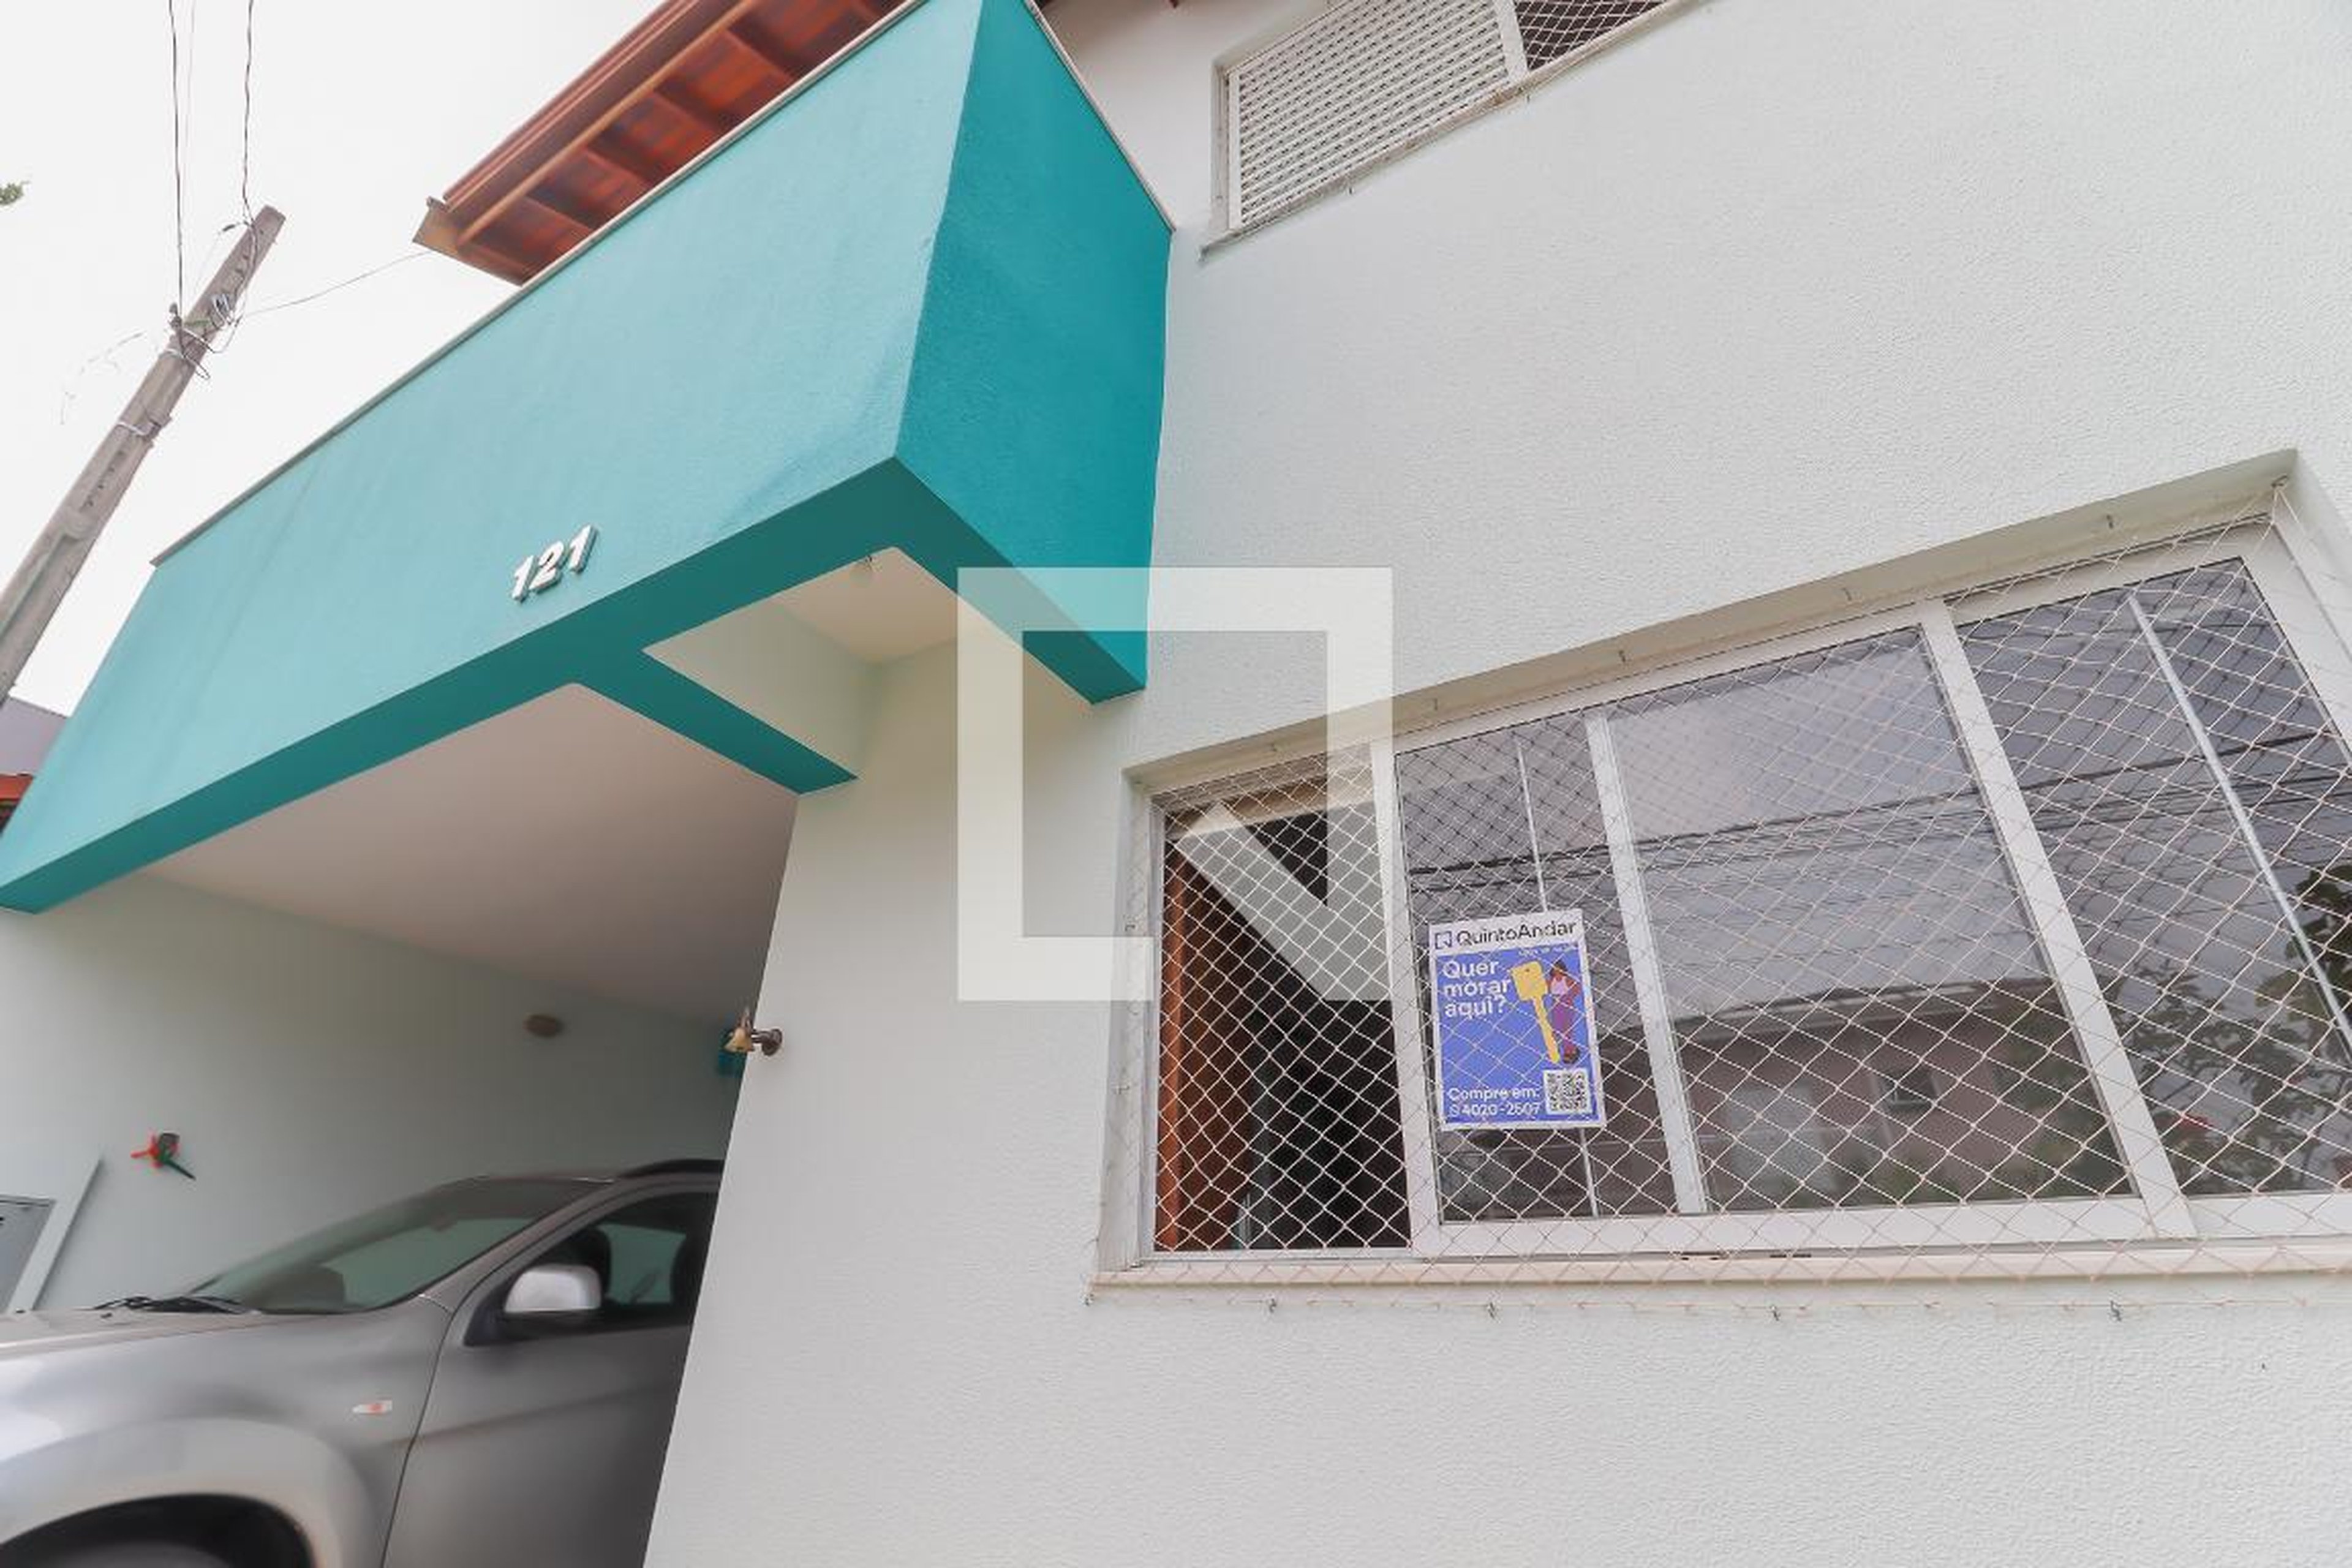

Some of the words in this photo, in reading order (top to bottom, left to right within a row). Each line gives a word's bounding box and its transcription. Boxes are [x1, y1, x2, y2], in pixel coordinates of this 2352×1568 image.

[511, 524, 598, 604] 121
[1457, 921, 1577, 946] QuintoAndar
[1442, 960, 1499, 979] Quer
[1444, 979, 1510, 997] morar
[1445, 993, 1506, 1018] aqui?
[1448, 1088, 1508, 1102] Compre
